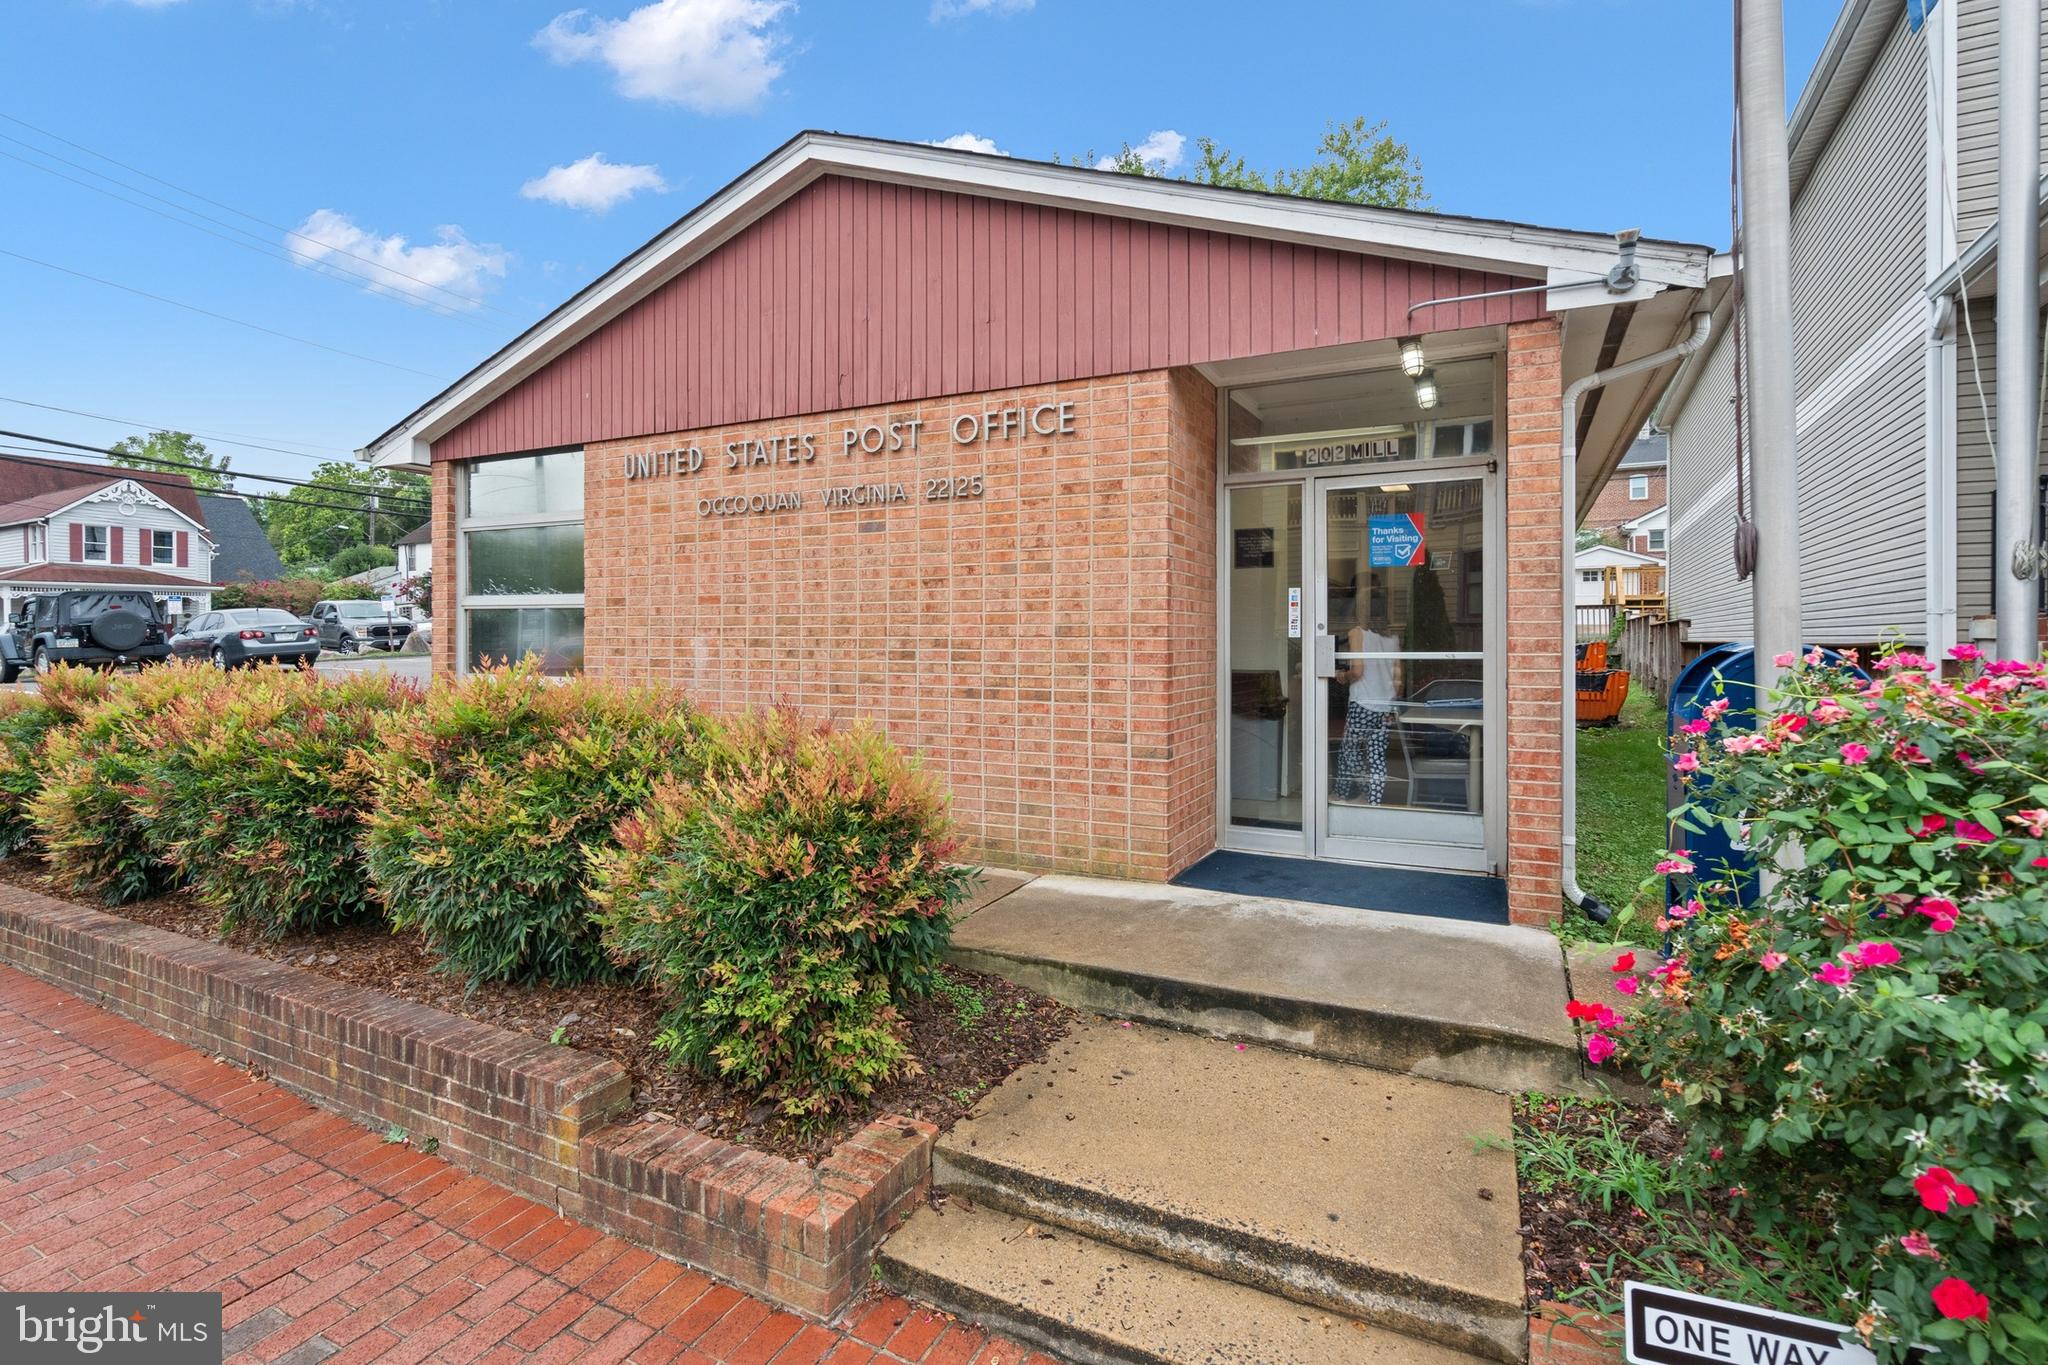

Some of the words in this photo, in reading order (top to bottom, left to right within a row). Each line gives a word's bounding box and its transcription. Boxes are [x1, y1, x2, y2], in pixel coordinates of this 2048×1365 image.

[624, 446, 704, 479] UNITED
[727, 433, 815, 469] STATES
[844, 420, 923, 457] POST
[952, 401, 1075, 445] OFFICE
[1308, 445, 1344, 463] 202
[1351, 441, 1398, 459] MILL
[697, 491, 802, 518] OCCOQUAN
[821, 483, 907, 507] VIRGINIA
[926, 475, 983, 499] 22125
[1372, 527, 1404, 535] Thanks
[1386, 535, 1419, 544] Visiting
[1655, 1315, 1731, 1358] ONE
[1747, 1333, 1829, 1365] WAY
